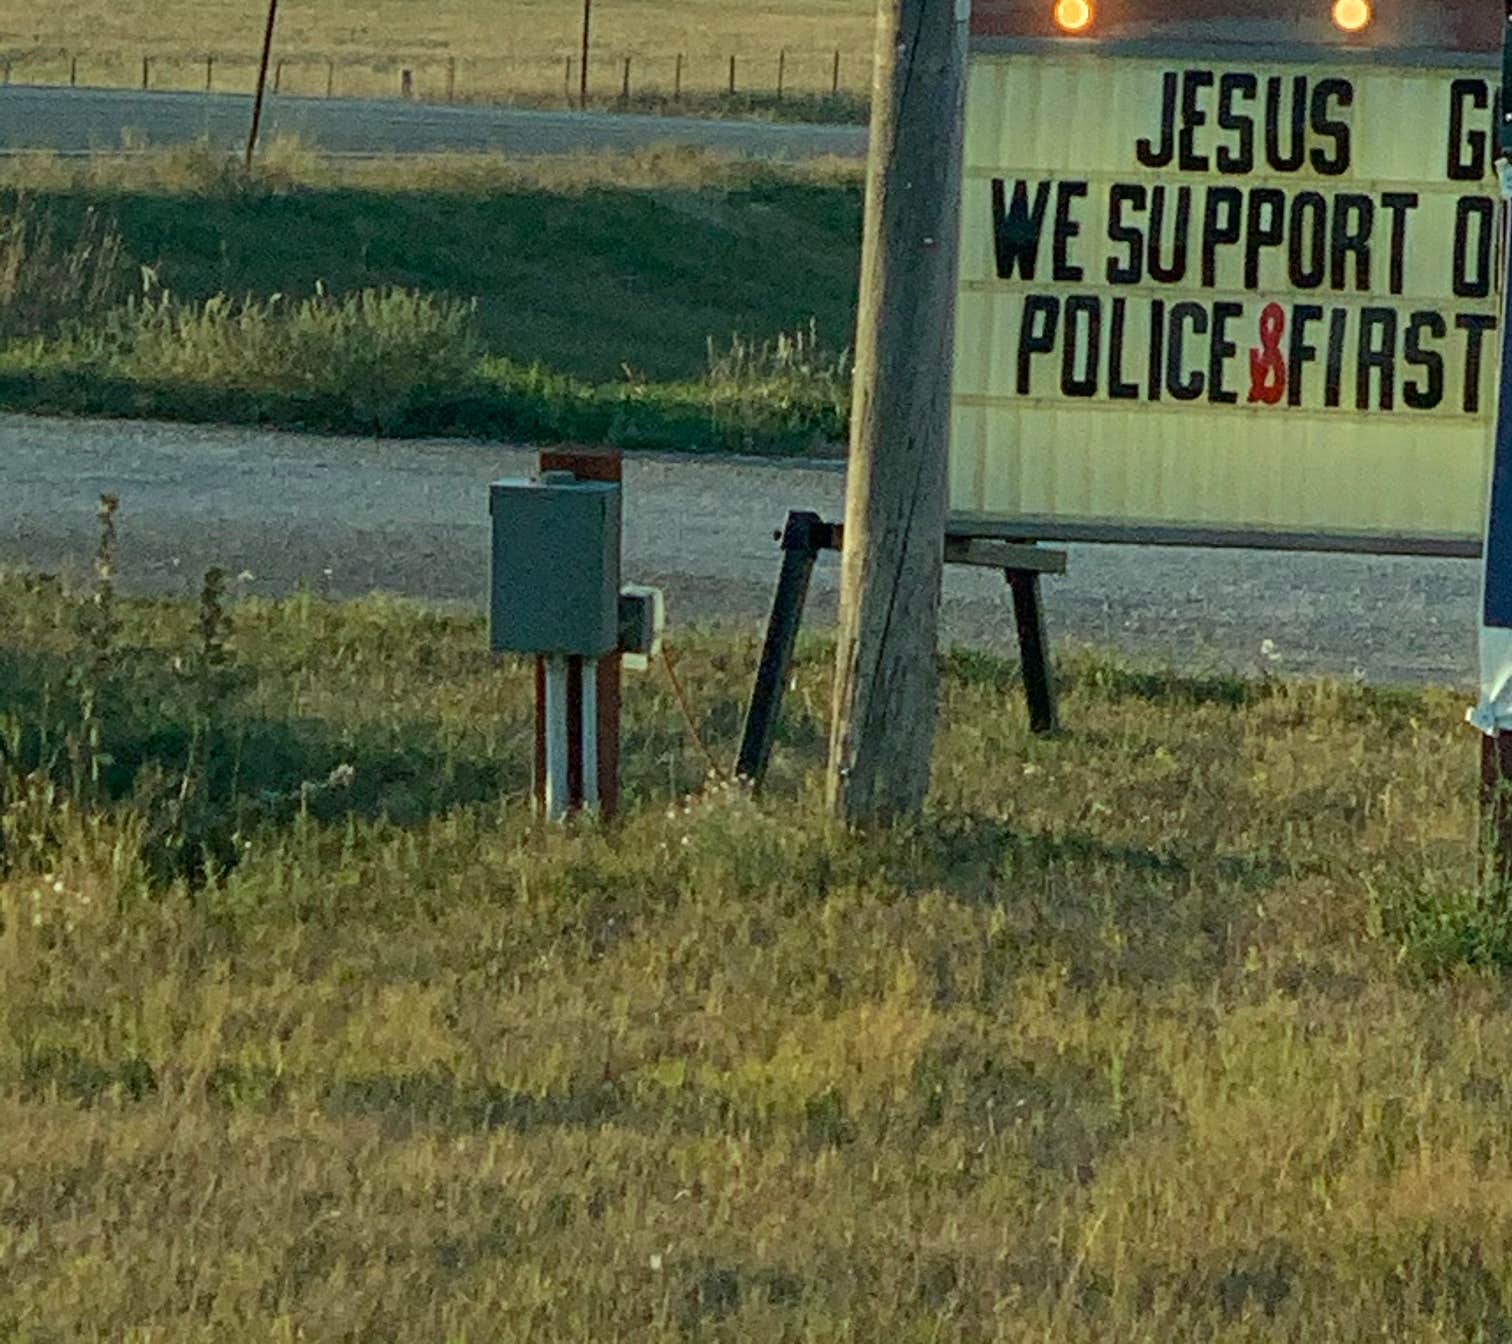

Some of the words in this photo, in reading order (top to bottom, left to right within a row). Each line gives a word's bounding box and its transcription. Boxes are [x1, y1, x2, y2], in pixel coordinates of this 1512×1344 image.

[1136, 70, 1354, 176] JESUS
[992, 178, 1088, 282] WE
[1106, 183, 1418, 295] SUPPORT
